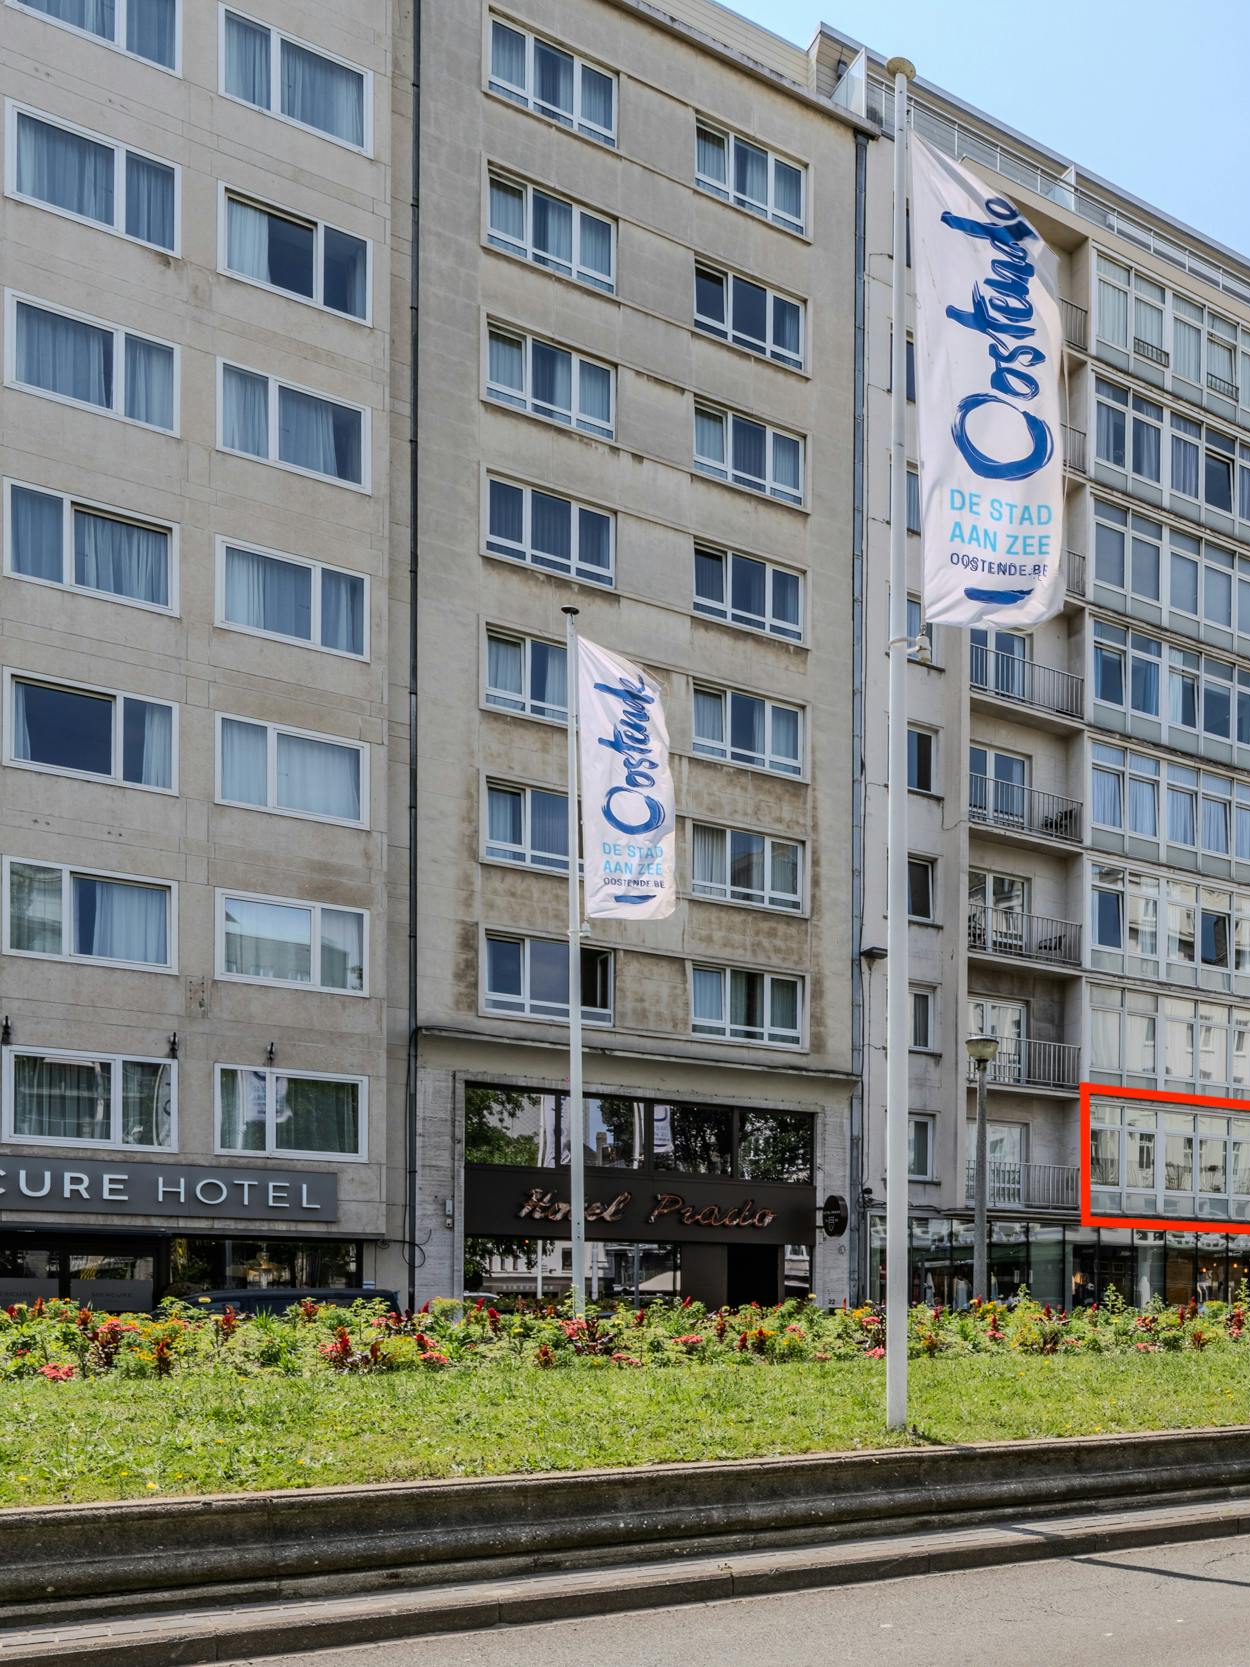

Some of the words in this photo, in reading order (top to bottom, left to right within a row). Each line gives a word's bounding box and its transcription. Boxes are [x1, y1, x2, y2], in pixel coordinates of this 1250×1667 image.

[940, 197, 1054, 480] Oostende
[950, 488, 981, 516] DE
[990, 498, 1052, 526] STAD
[949, 521, 997, 553] AAN
[1005, 534, 1051, 556] ZEE
[950, 552, 1048, 577] OOSTENDE.BE
[594, 673, 665, 835] Oostende
[603, 842, 622, 856] DE
[627, 845, 664, 859] STAD
[604, 860, 632, 875] AAN
[638, 863, 663, 875] ZEE
[0, 1169, 129, 1200] URE
[158, 1176, 321, 1209] HOTEL
[516, 1188, 632, 1222] Hoel
[648, 1193, 777, 1228] Prado
